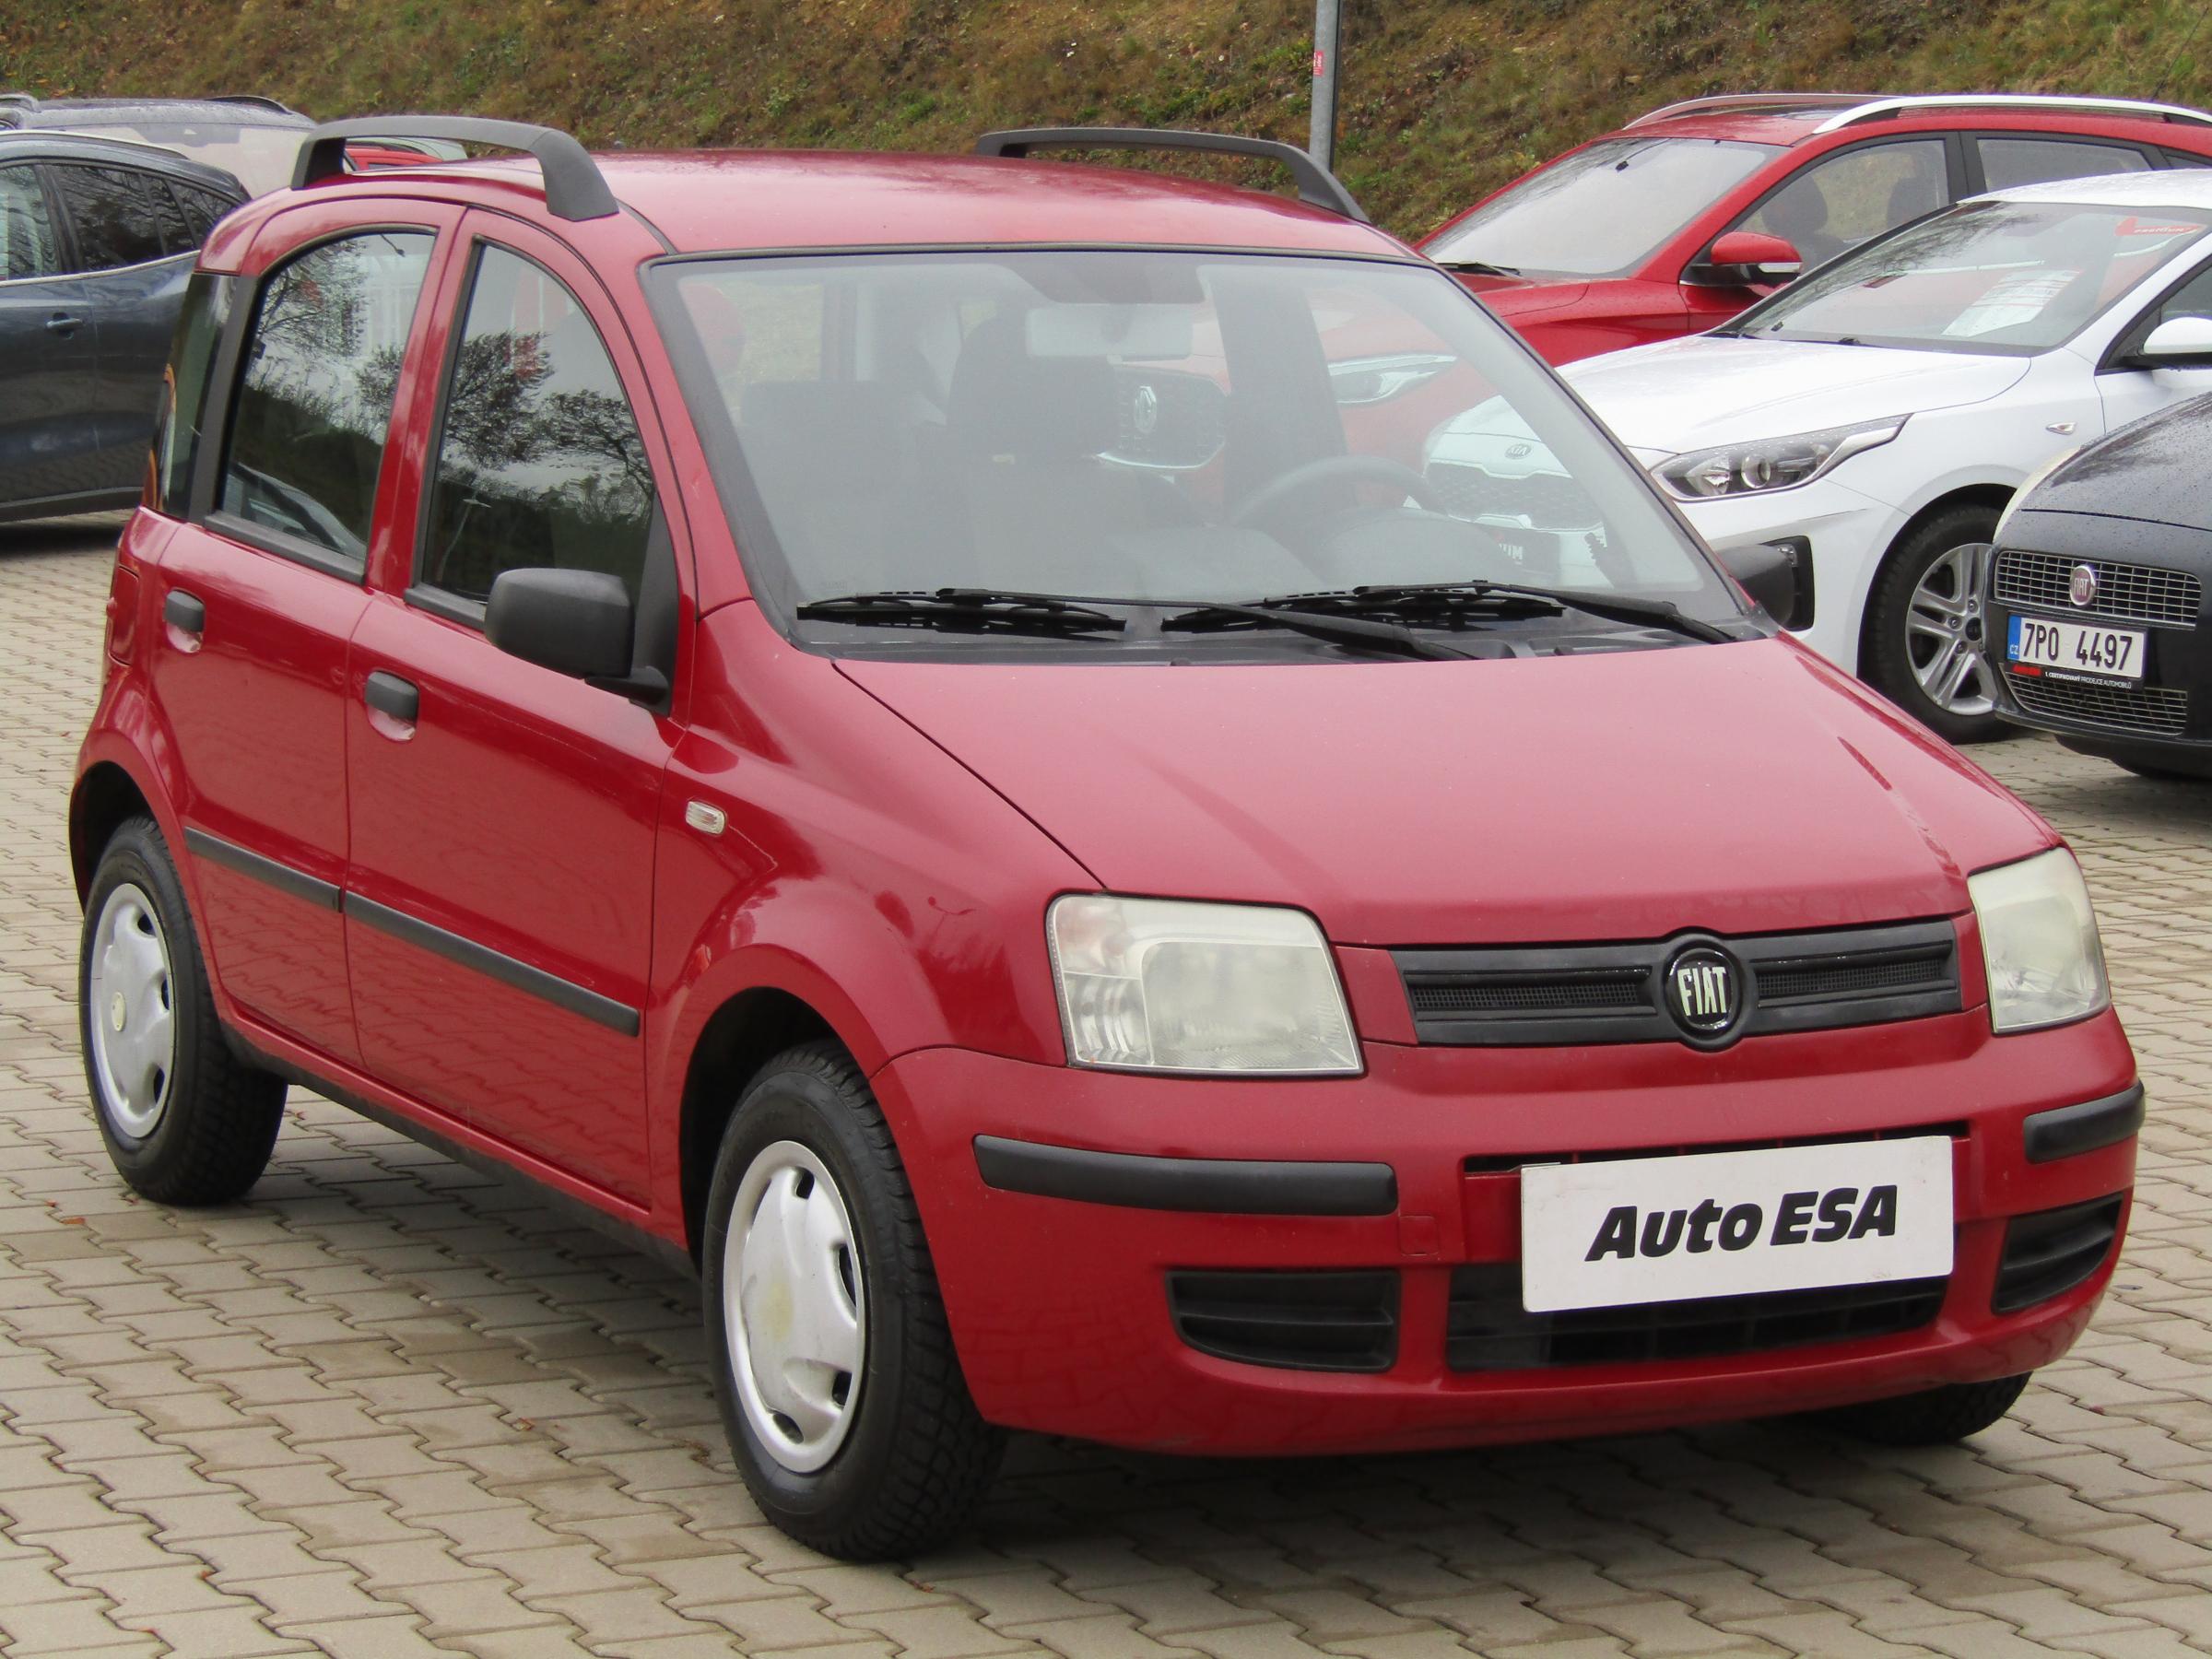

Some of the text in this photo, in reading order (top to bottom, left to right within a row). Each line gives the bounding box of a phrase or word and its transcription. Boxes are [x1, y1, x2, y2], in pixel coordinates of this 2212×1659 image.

[2074, 577, 2088, 596] FIAT
[2009, 644, 2019, 655] CZ
[2076, 630, 2133, 670] 4497
[1677, 966, 1727, 1017] FIAT
[1584, 1184, 1898, 1262] Auto ESA
